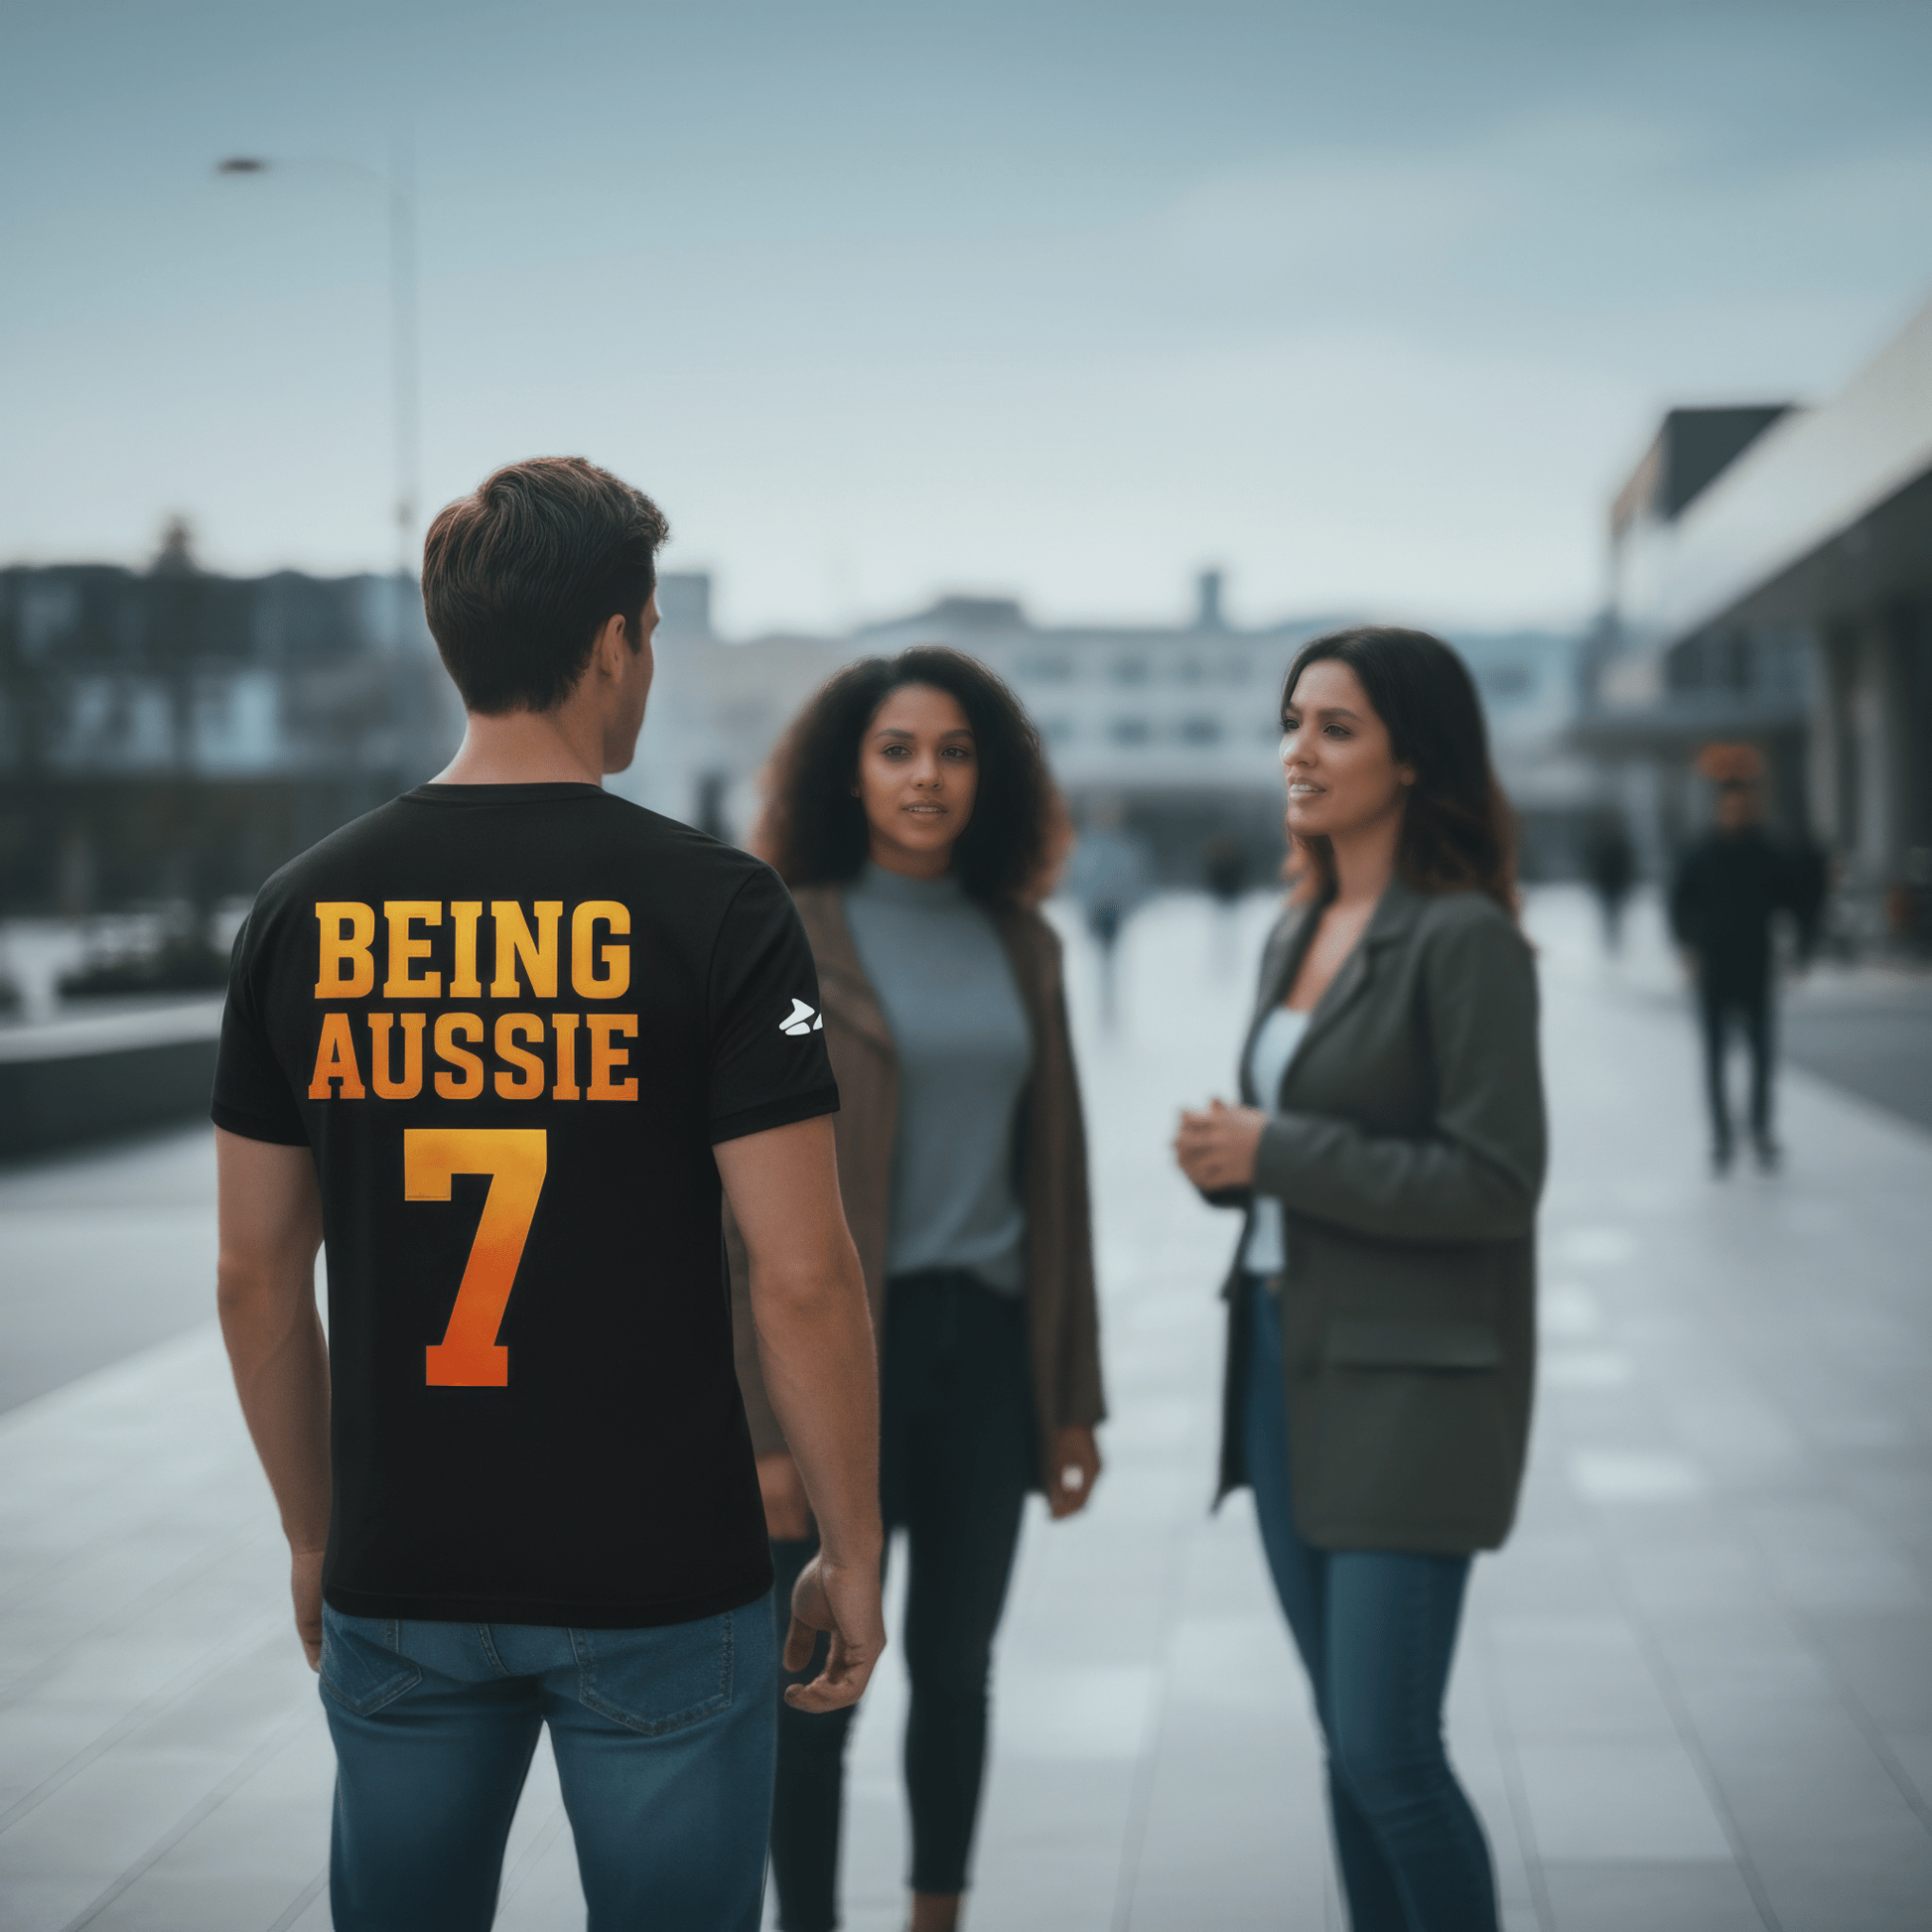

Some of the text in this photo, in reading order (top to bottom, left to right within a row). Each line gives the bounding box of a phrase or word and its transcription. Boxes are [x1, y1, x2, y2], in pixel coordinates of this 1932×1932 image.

[314, 900, 631, 1000] BEING
[308, 1013, 638, 1101] AUSSIE
[403, 1128, 548, 1387] 7
